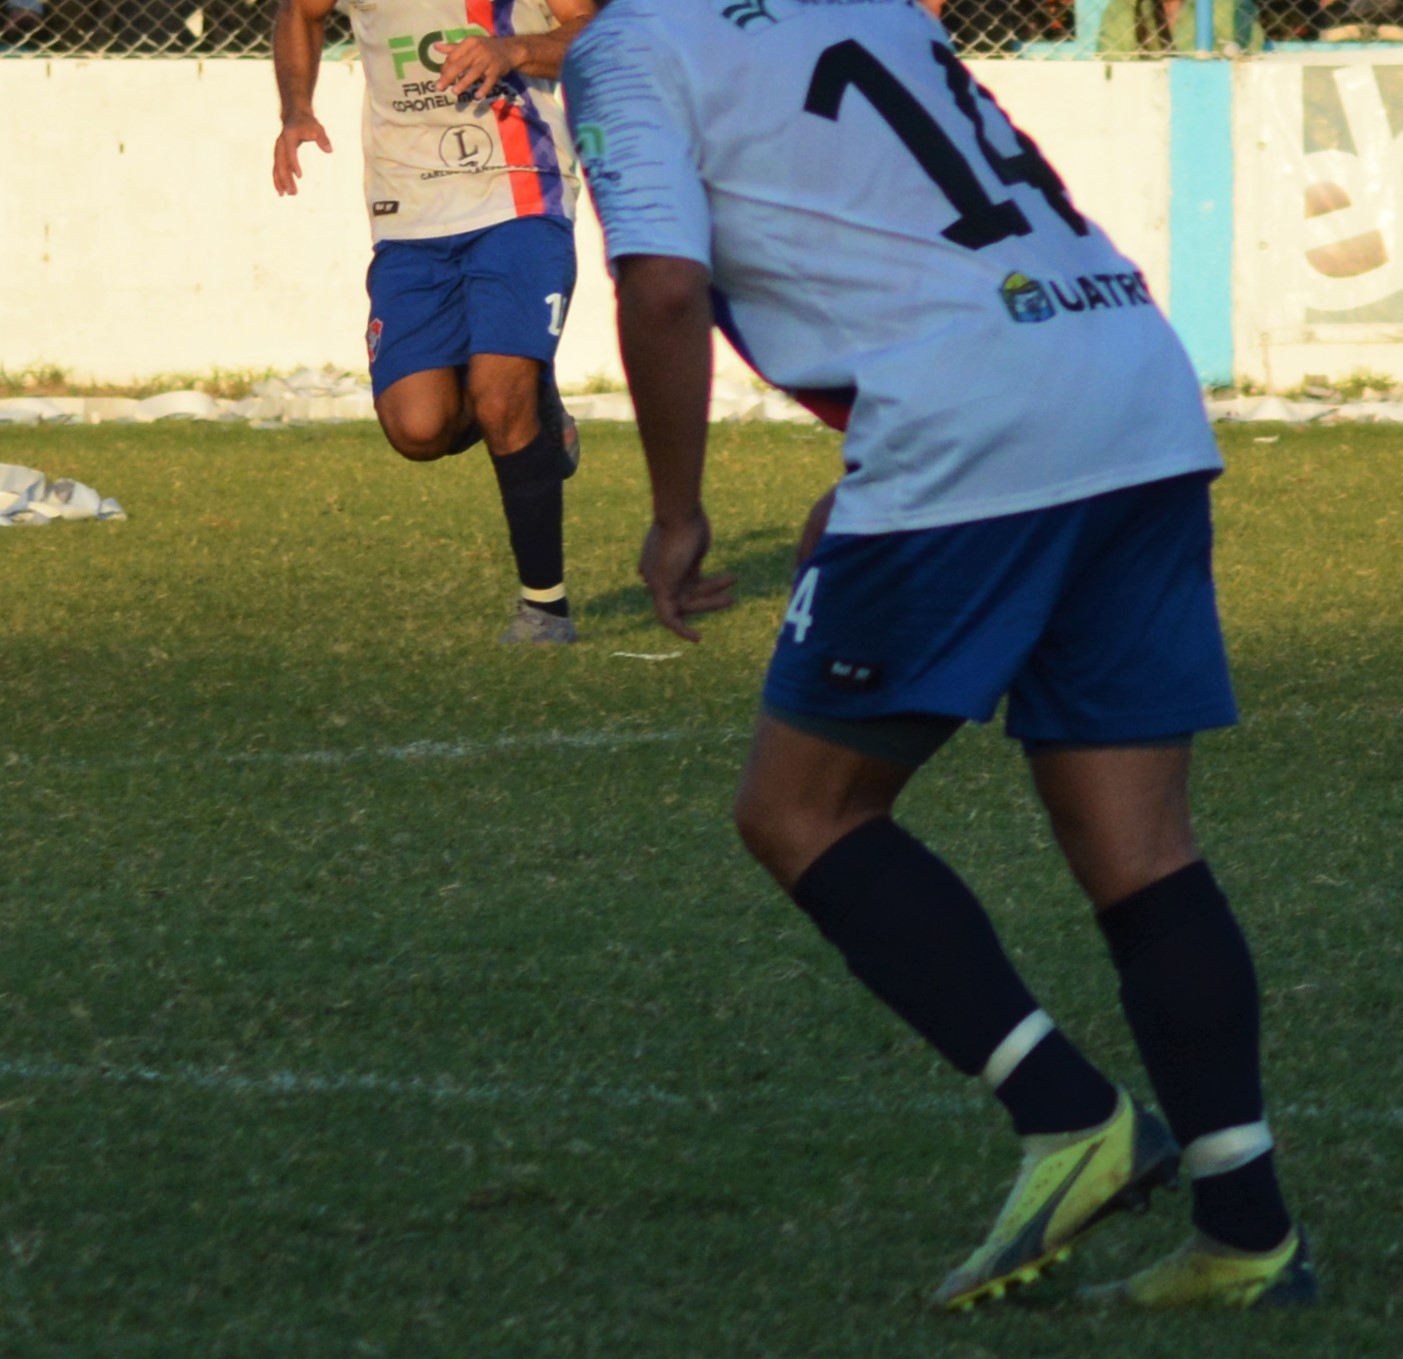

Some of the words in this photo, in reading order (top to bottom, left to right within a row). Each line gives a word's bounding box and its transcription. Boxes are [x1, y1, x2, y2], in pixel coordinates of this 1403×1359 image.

[392, 94, 456, 113] CORONEL
[804, 37, 1091, 251] 14
[784, 566, 820, 643] 4
